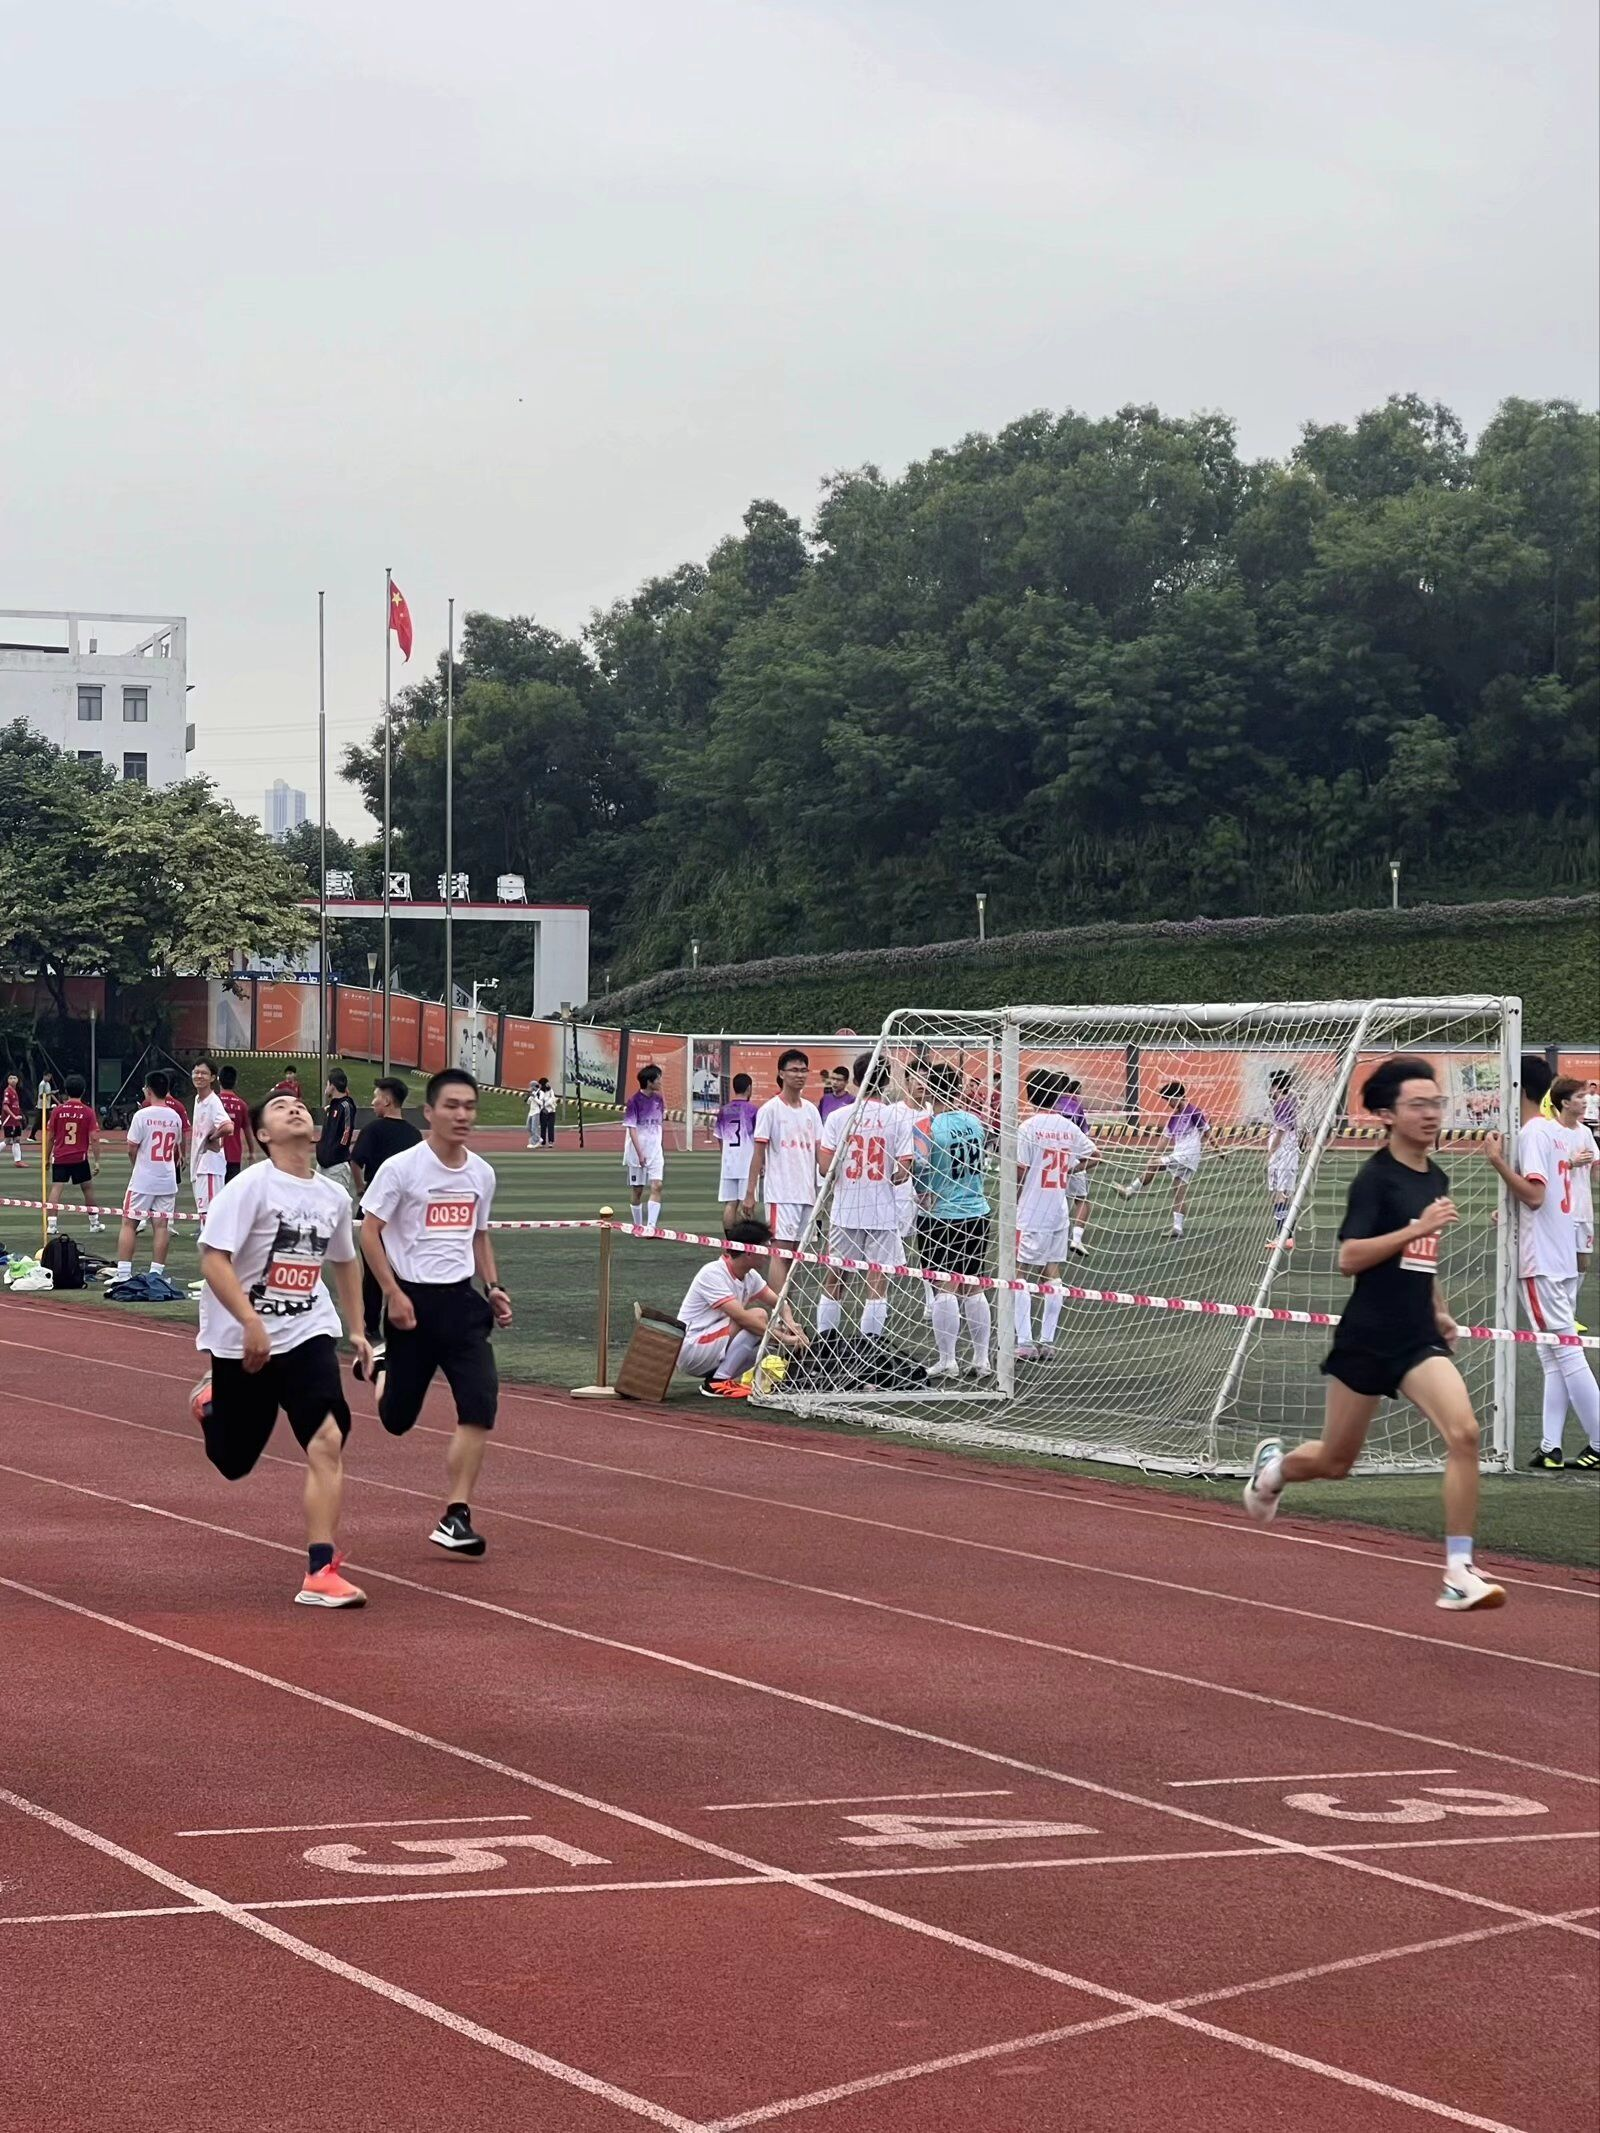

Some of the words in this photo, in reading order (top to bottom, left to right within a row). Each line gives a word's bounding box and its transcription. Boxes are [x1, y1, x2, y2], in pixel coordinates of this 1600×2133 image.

[64, 1122, 77, 1145] 3
[728, 1120, 741, 1147] 3
[845, 1134, 886, 1181] 39
[430, 1205, 470, 1223] 0039
[1408, 1237, 1438, 1257] 017
[274, 1266, 316, 1287] 0061
[1281, 1787, 1550, 1823] 3
[838, 1814, 1102, 1850] 4
[302, 1835, 612, 1875] 5
